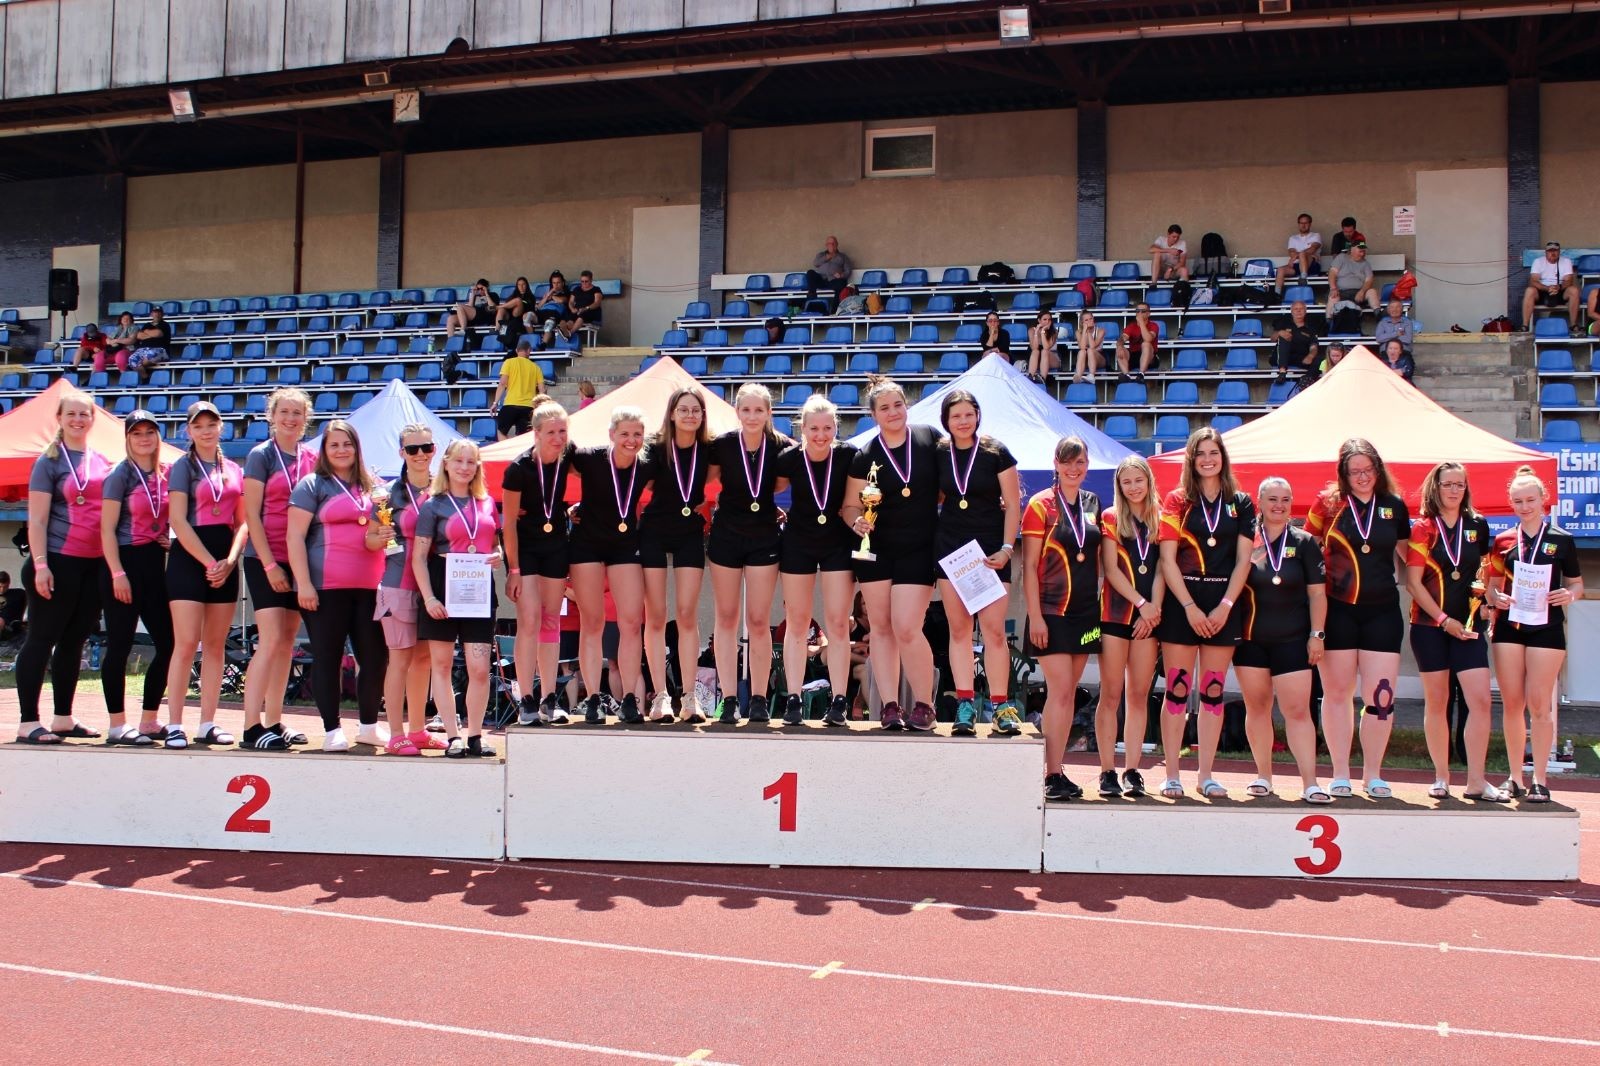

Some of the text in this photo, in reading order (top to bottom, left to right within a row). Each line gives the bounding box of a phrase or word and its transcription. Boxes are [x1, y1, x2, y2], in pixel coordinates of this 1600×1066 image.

[1565, 522, 1579, 530] 222
[452, 570, 485, 578] DIPLOM
[953, 558, 983, 578] DIPLOM
[1517, 578, 1546, 589] DIPLOM
[225, 774, 271, 833] 2
[763, 772, 798, 832] 1
[1294, 814, 1342, 875] 3
